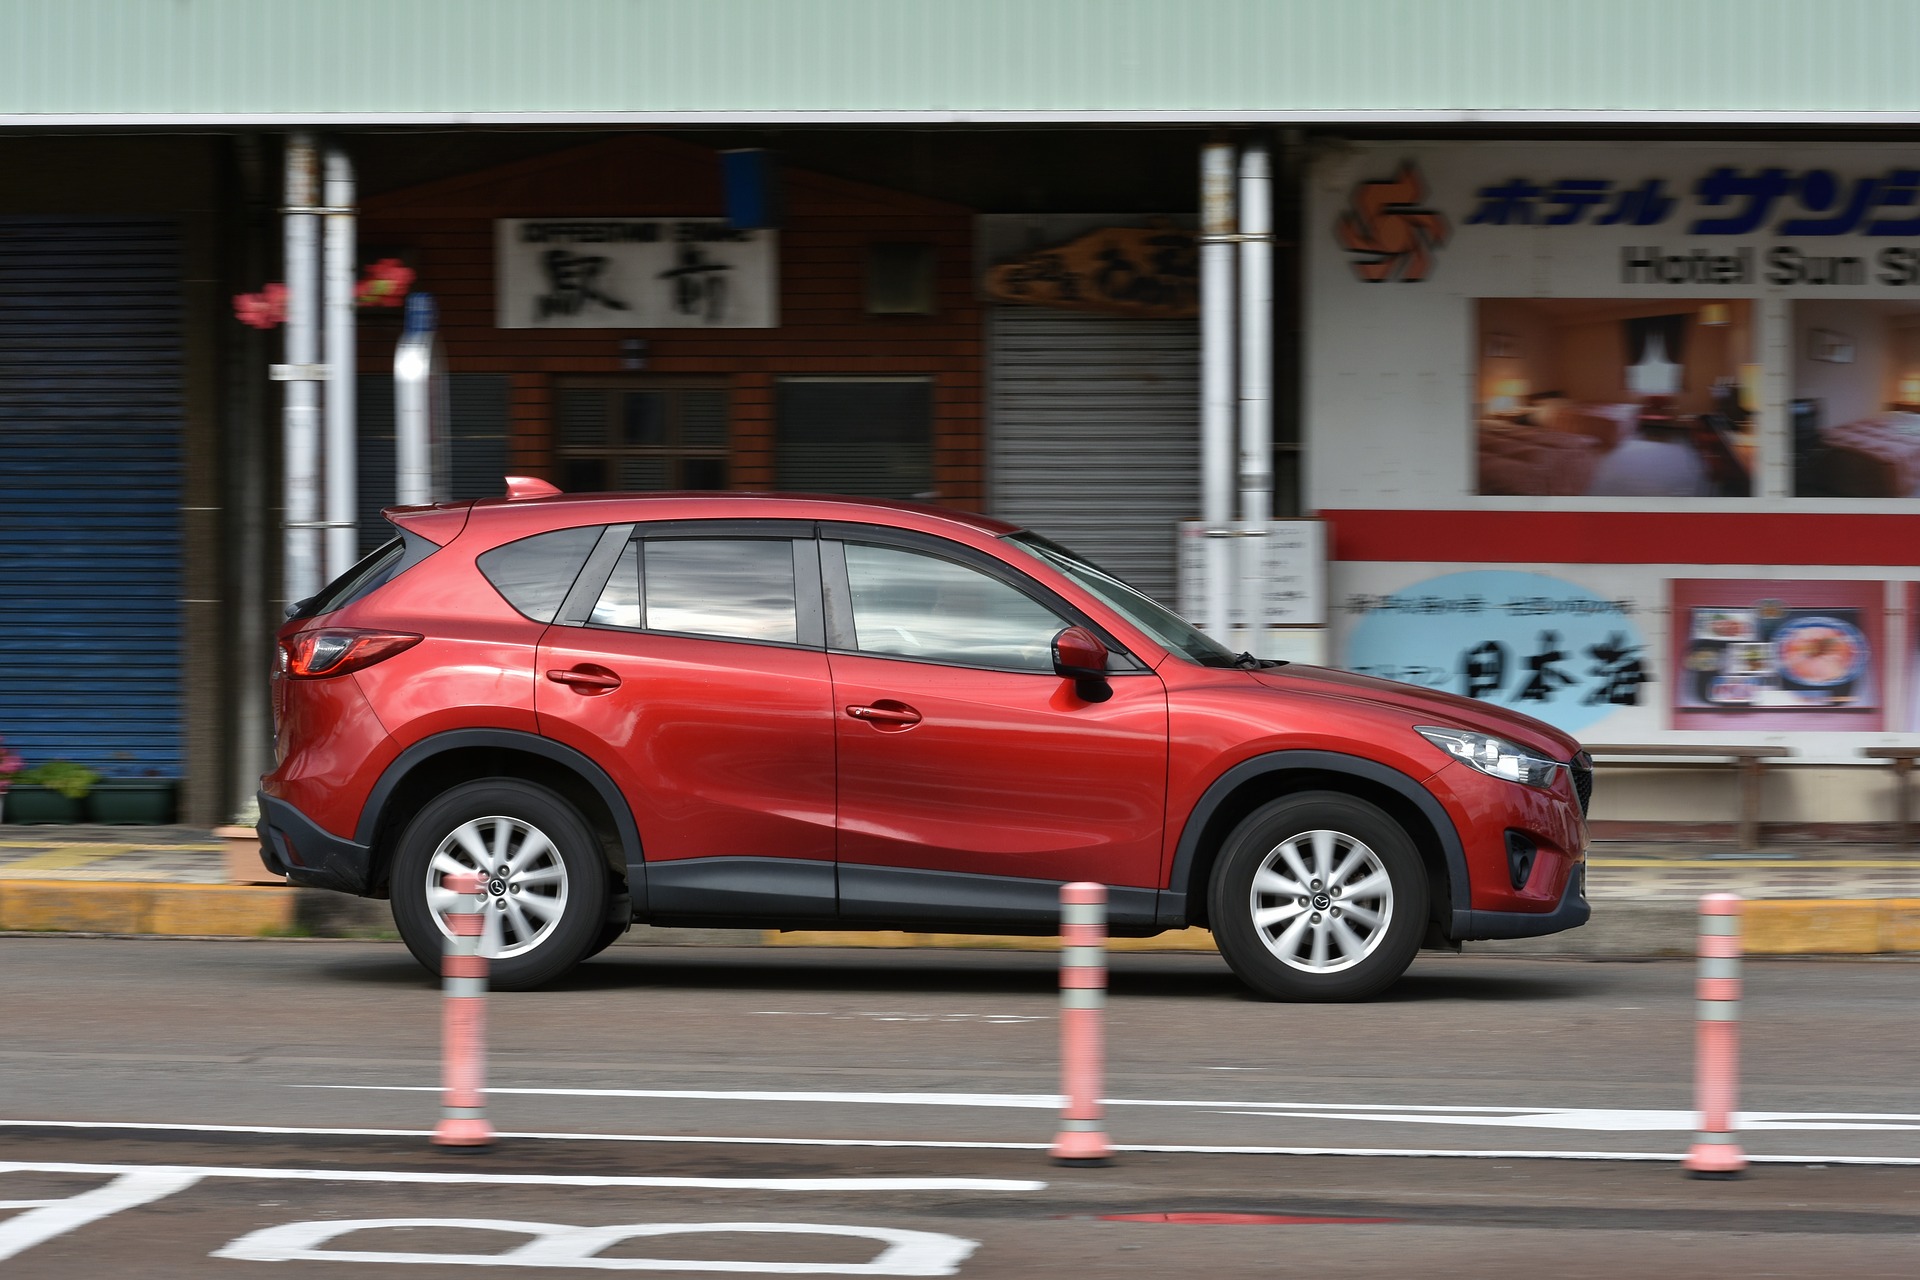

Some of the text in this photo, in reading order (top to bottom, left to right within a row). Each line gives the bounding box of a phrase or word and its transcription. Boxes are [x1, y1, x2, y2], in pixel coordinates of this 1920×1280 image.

[1466, 178, 1676, 226] ホテル
[533, 248, 736, 326] 駅前
[1622, 245, 1755, 285] Hotel
[1764, 245, 1868, 286] Sun
[1457, 630, 1654, 706] 日本海
